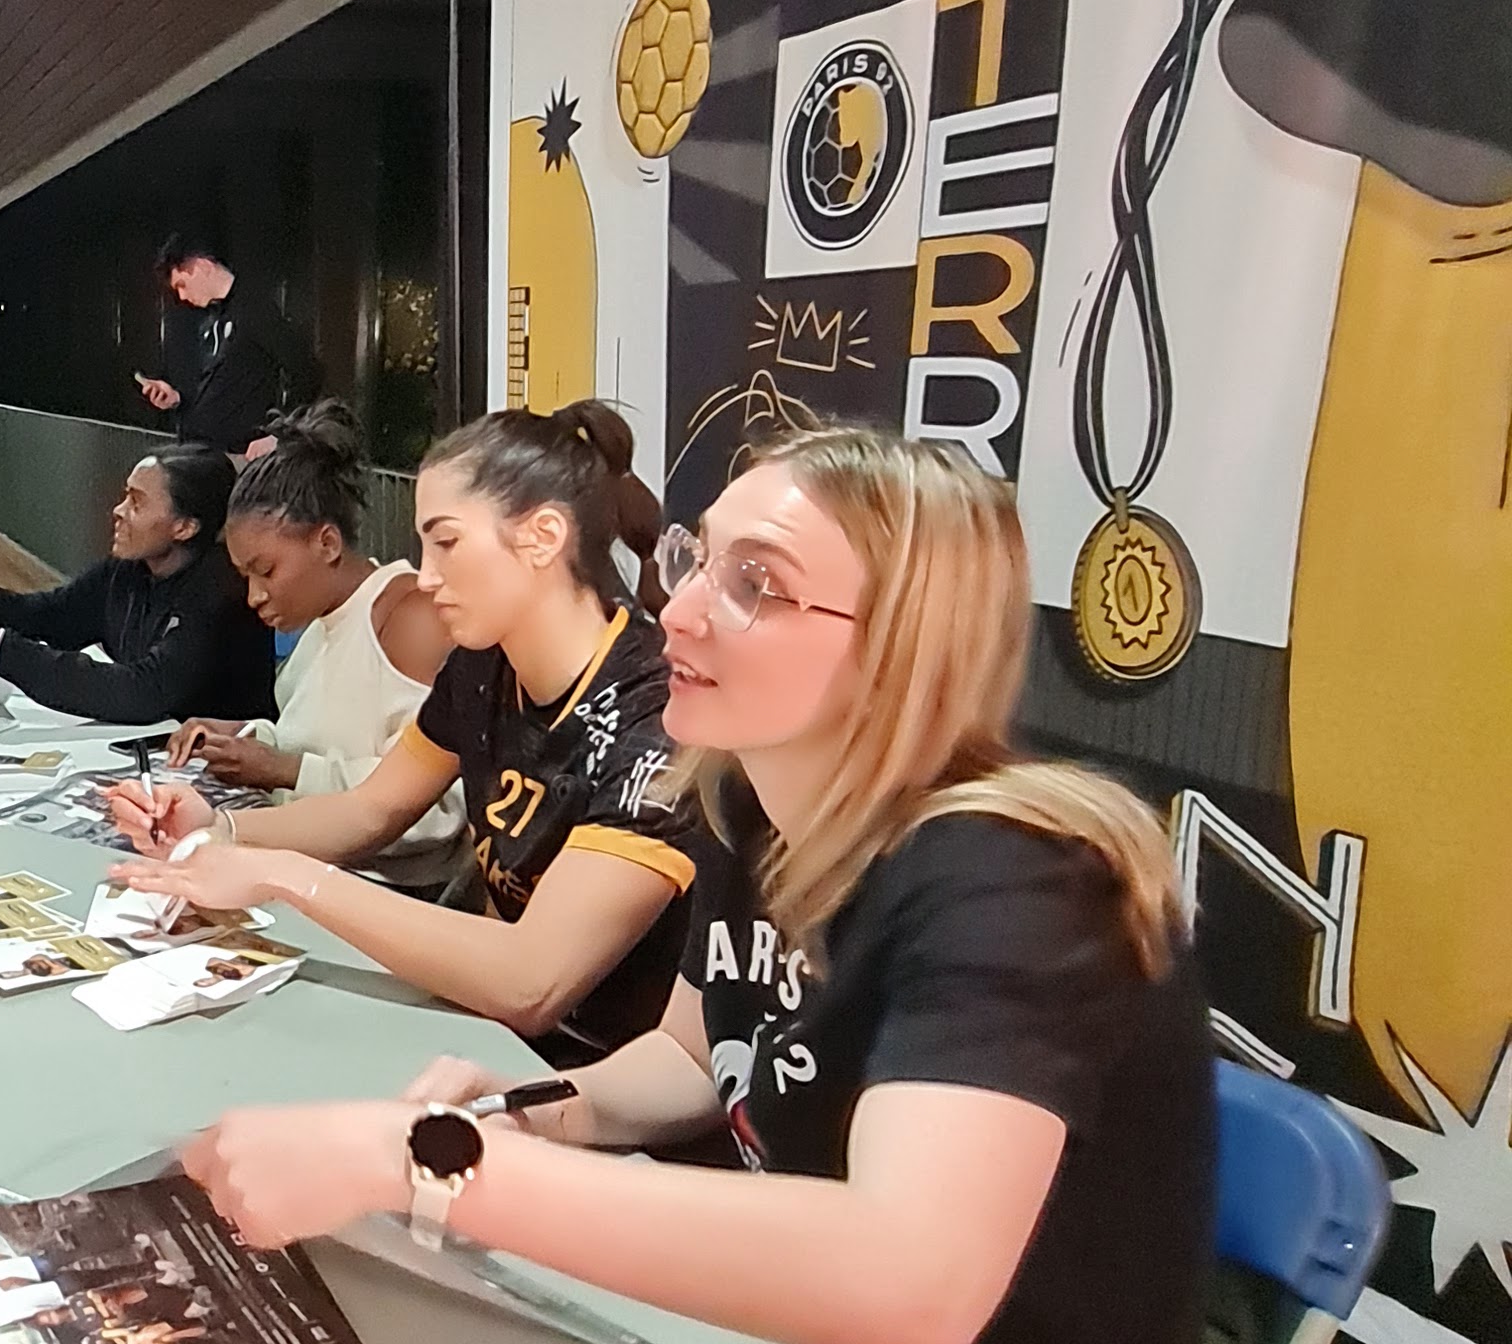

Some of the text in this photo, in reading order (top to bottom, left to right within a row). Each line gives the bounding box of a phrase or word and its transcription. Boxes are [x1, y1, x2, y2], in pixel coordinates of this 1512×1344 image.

[801, 53, 869, 117] PARIS
[486, 769, 546, 838] 27
[706, 920, 812, 1011] ARS
